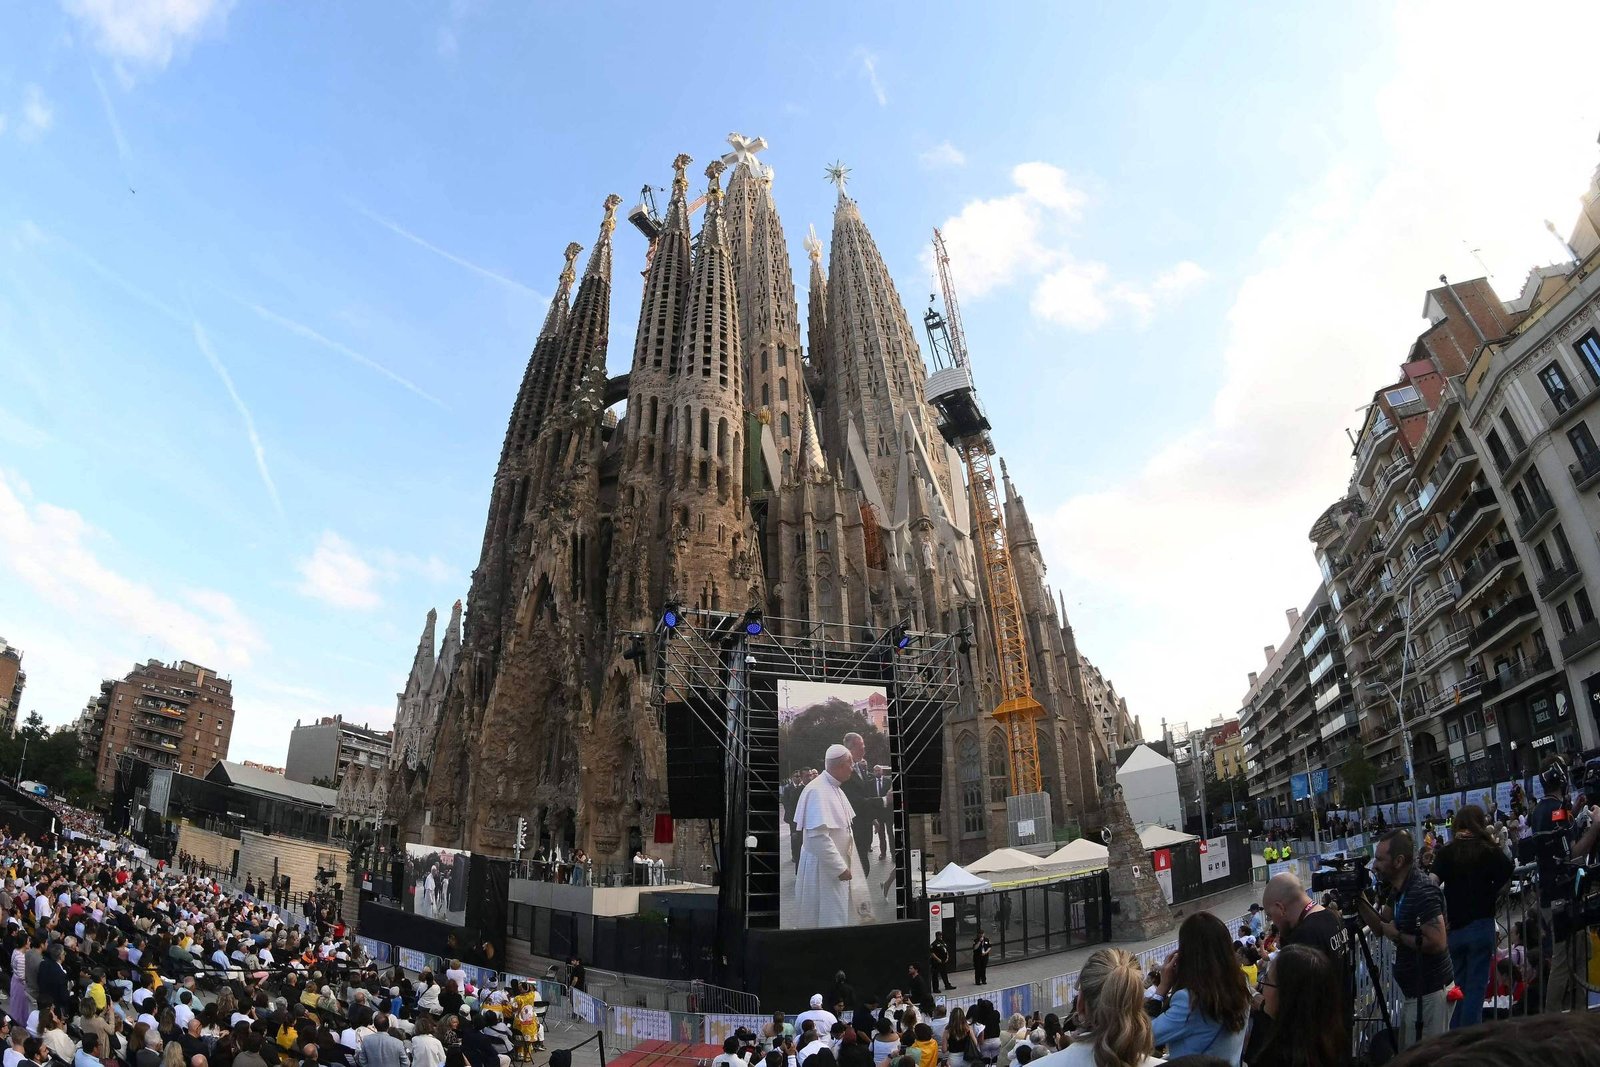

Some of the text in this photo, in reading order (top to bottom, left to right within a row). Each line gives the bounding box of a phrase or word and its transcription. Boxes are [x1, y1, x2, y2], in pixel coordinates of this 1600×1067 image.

[1533, 700, 1548, 712] TACO
[1536, 711, 1551, 723] BELL
[1531, 735, 1555, 748] TACO BELL
